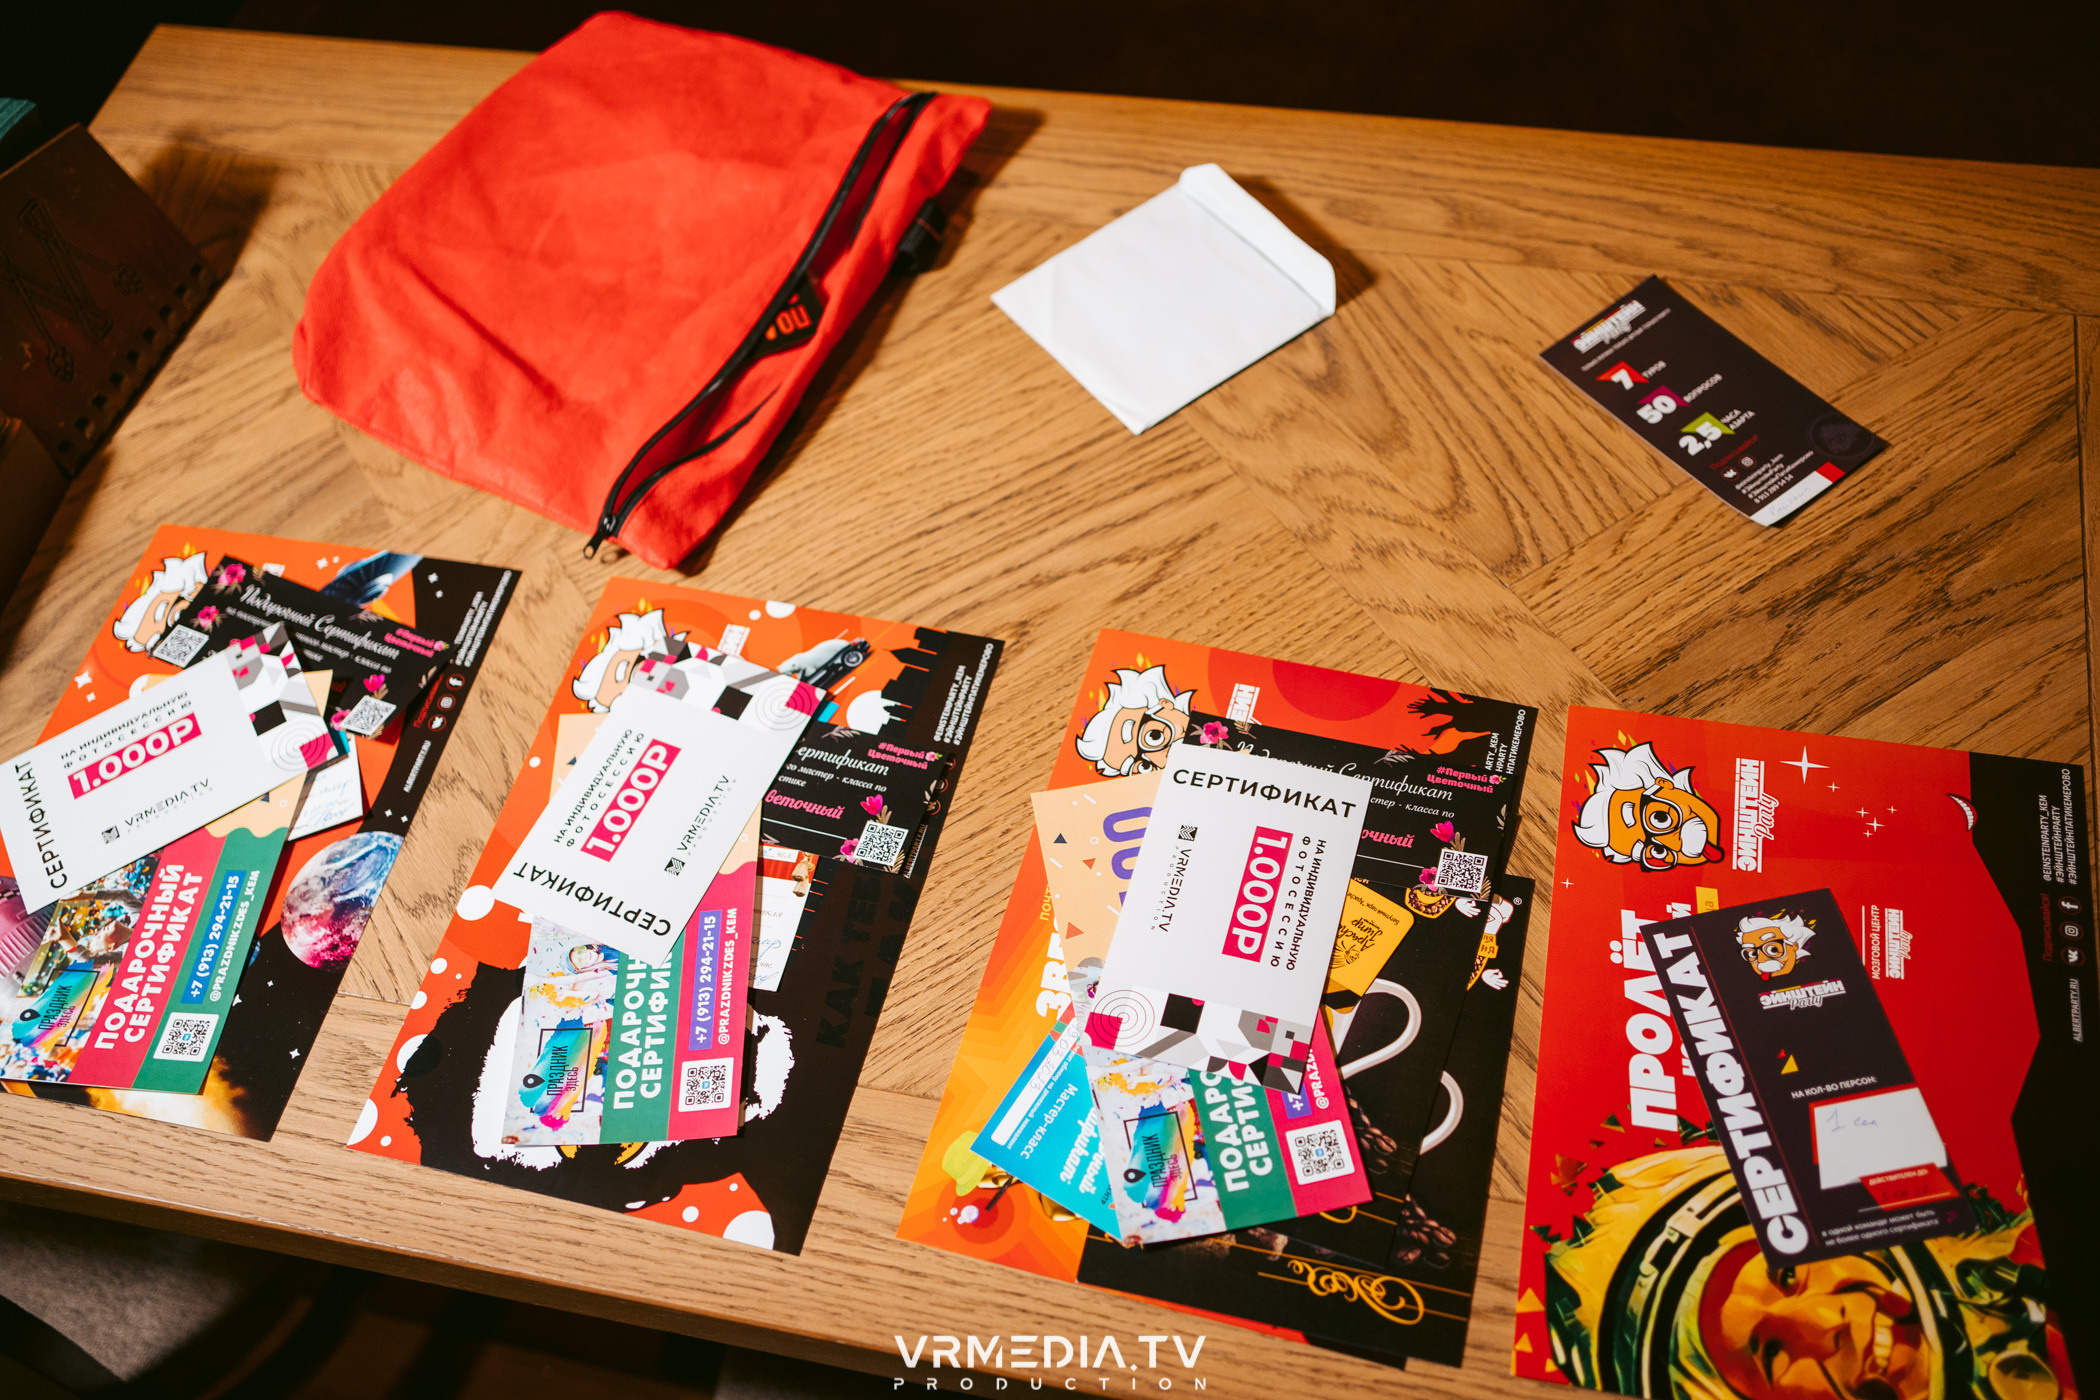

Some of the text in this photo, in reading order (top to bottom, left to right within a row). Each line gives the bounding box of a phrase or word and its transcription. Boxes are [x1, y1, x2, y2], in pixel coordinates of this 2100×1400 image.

[1611, 369, 1633, 390] 7
[1636, 374, 1722, 424] 50 ВОПРОСОВ
[1679, 421, 1722, 456] 2,5
[80, 691, 188, 750] ИНДИВИДУАЛЬНУЮ
[1506, 709, 1526, 775] НПАТИКЕМЕРОВО
[797, 745, 890, 777] ертификат
[797, 766, 833, 781] мастер
[842, 776, 874, 791] класса
[874, 784, 887, 793] по
[867, 749, 928, 770] Цветочный
[878, 742, 926, 760] #Первый
[1437, 766, 1488, 783] #Первый
[1484, 732, 1499, 771] ARTY_KEM
[554, 729, 633, 843] НА ИНДИВИДУАЛЬНУЮ
[566, 732, 644, 848] ФОТОСЕССИЮ
[765, 789, 846, 820] веточный
[778, 775, 807, 787] стике
[1172, 769, 1356, 818] СЕРТИФИКАТ
[1370, 796, 1455, 818] стер класса по
[1427, 774, 1494, 794] Цветочный
[15, 761, 68, 889] СЕРТИФИКАТ
[676, 775, 730, 852] VRMEDIA.TV
[1361, 829, 1415, 849] очный
[1732, 758, 1764, 872] ЭЙНШТЕЙН
[1753, 793, 1779, 840] Party
[2039, 794, 2052, 882] @EINSTEINPARTY_KEM
[2063, 768, 2078, 885] #ЭЙНШТЕЙНПАТИКЕМЕРОВО
[2051, 806, 2065, 884] #ЭЙНШТЕЙНPARTY
[513, 862, 672, 936] СЕРТИФИКАТ
[1158, 848, 1192, 933] VRMEDIA.TV
[1270, 835, 1311, 967] ФОТОСЕССИЮ
[1286, 839, 1327, 971] НА ИНДИВИДУАЛЬНУЮ
[189, 875, 240, 998] +7 (913) 294-21-15
[209, 870, 260, 1002] @PRAZDNIKZDES_KEM
[1350, 917, 1383, 943] Jump
[1871, 905, 1881, 980] МОЗГОВОЙ ЦЕНТР
[2040, 893, 2054, 962] Подписывайся!
[94, 864, 185, 1050] ПОДАРОЧНЫЙ
[123, 872, 203, 1043] СЕРТИФИКАТ
[694, 915, 718, 1044] +7 (913) 294-21-15
[717, 908, 738, 1045] @PRAZDNIKZDES_KEM
[38, 984, 72, 1031] ПРАЗДНИК
[57, 1005, 75, 1027] ЗДЕСЬ
[1760, 980, 1846, 1008] ЭЙНШТЕЙН
[1789, 995, 1824, 1010] Party
[2071, 978, 2083, 1042] ALBERTPARTY.RU
[547, 1045, 569, 1096] ПРАЗДНИК
[565, 1066, 579, 1092] ЗДЕСЬ
[1653, 932, 1809, 1255] СЕРТИФИКАТ
[1791, 1076, 1878, 1099] НА КОЛ-ВО ПЕРСОН:
[1020, 1083, 1079, 1160] Мастер-класс
[1201, 1071, 1249, 1192] ПОДАРО
[1142, 1133, 1168, 1188] ПРАЗДНИК
[1167, 1153, 1182, 1180] ЗДЕСЬ
